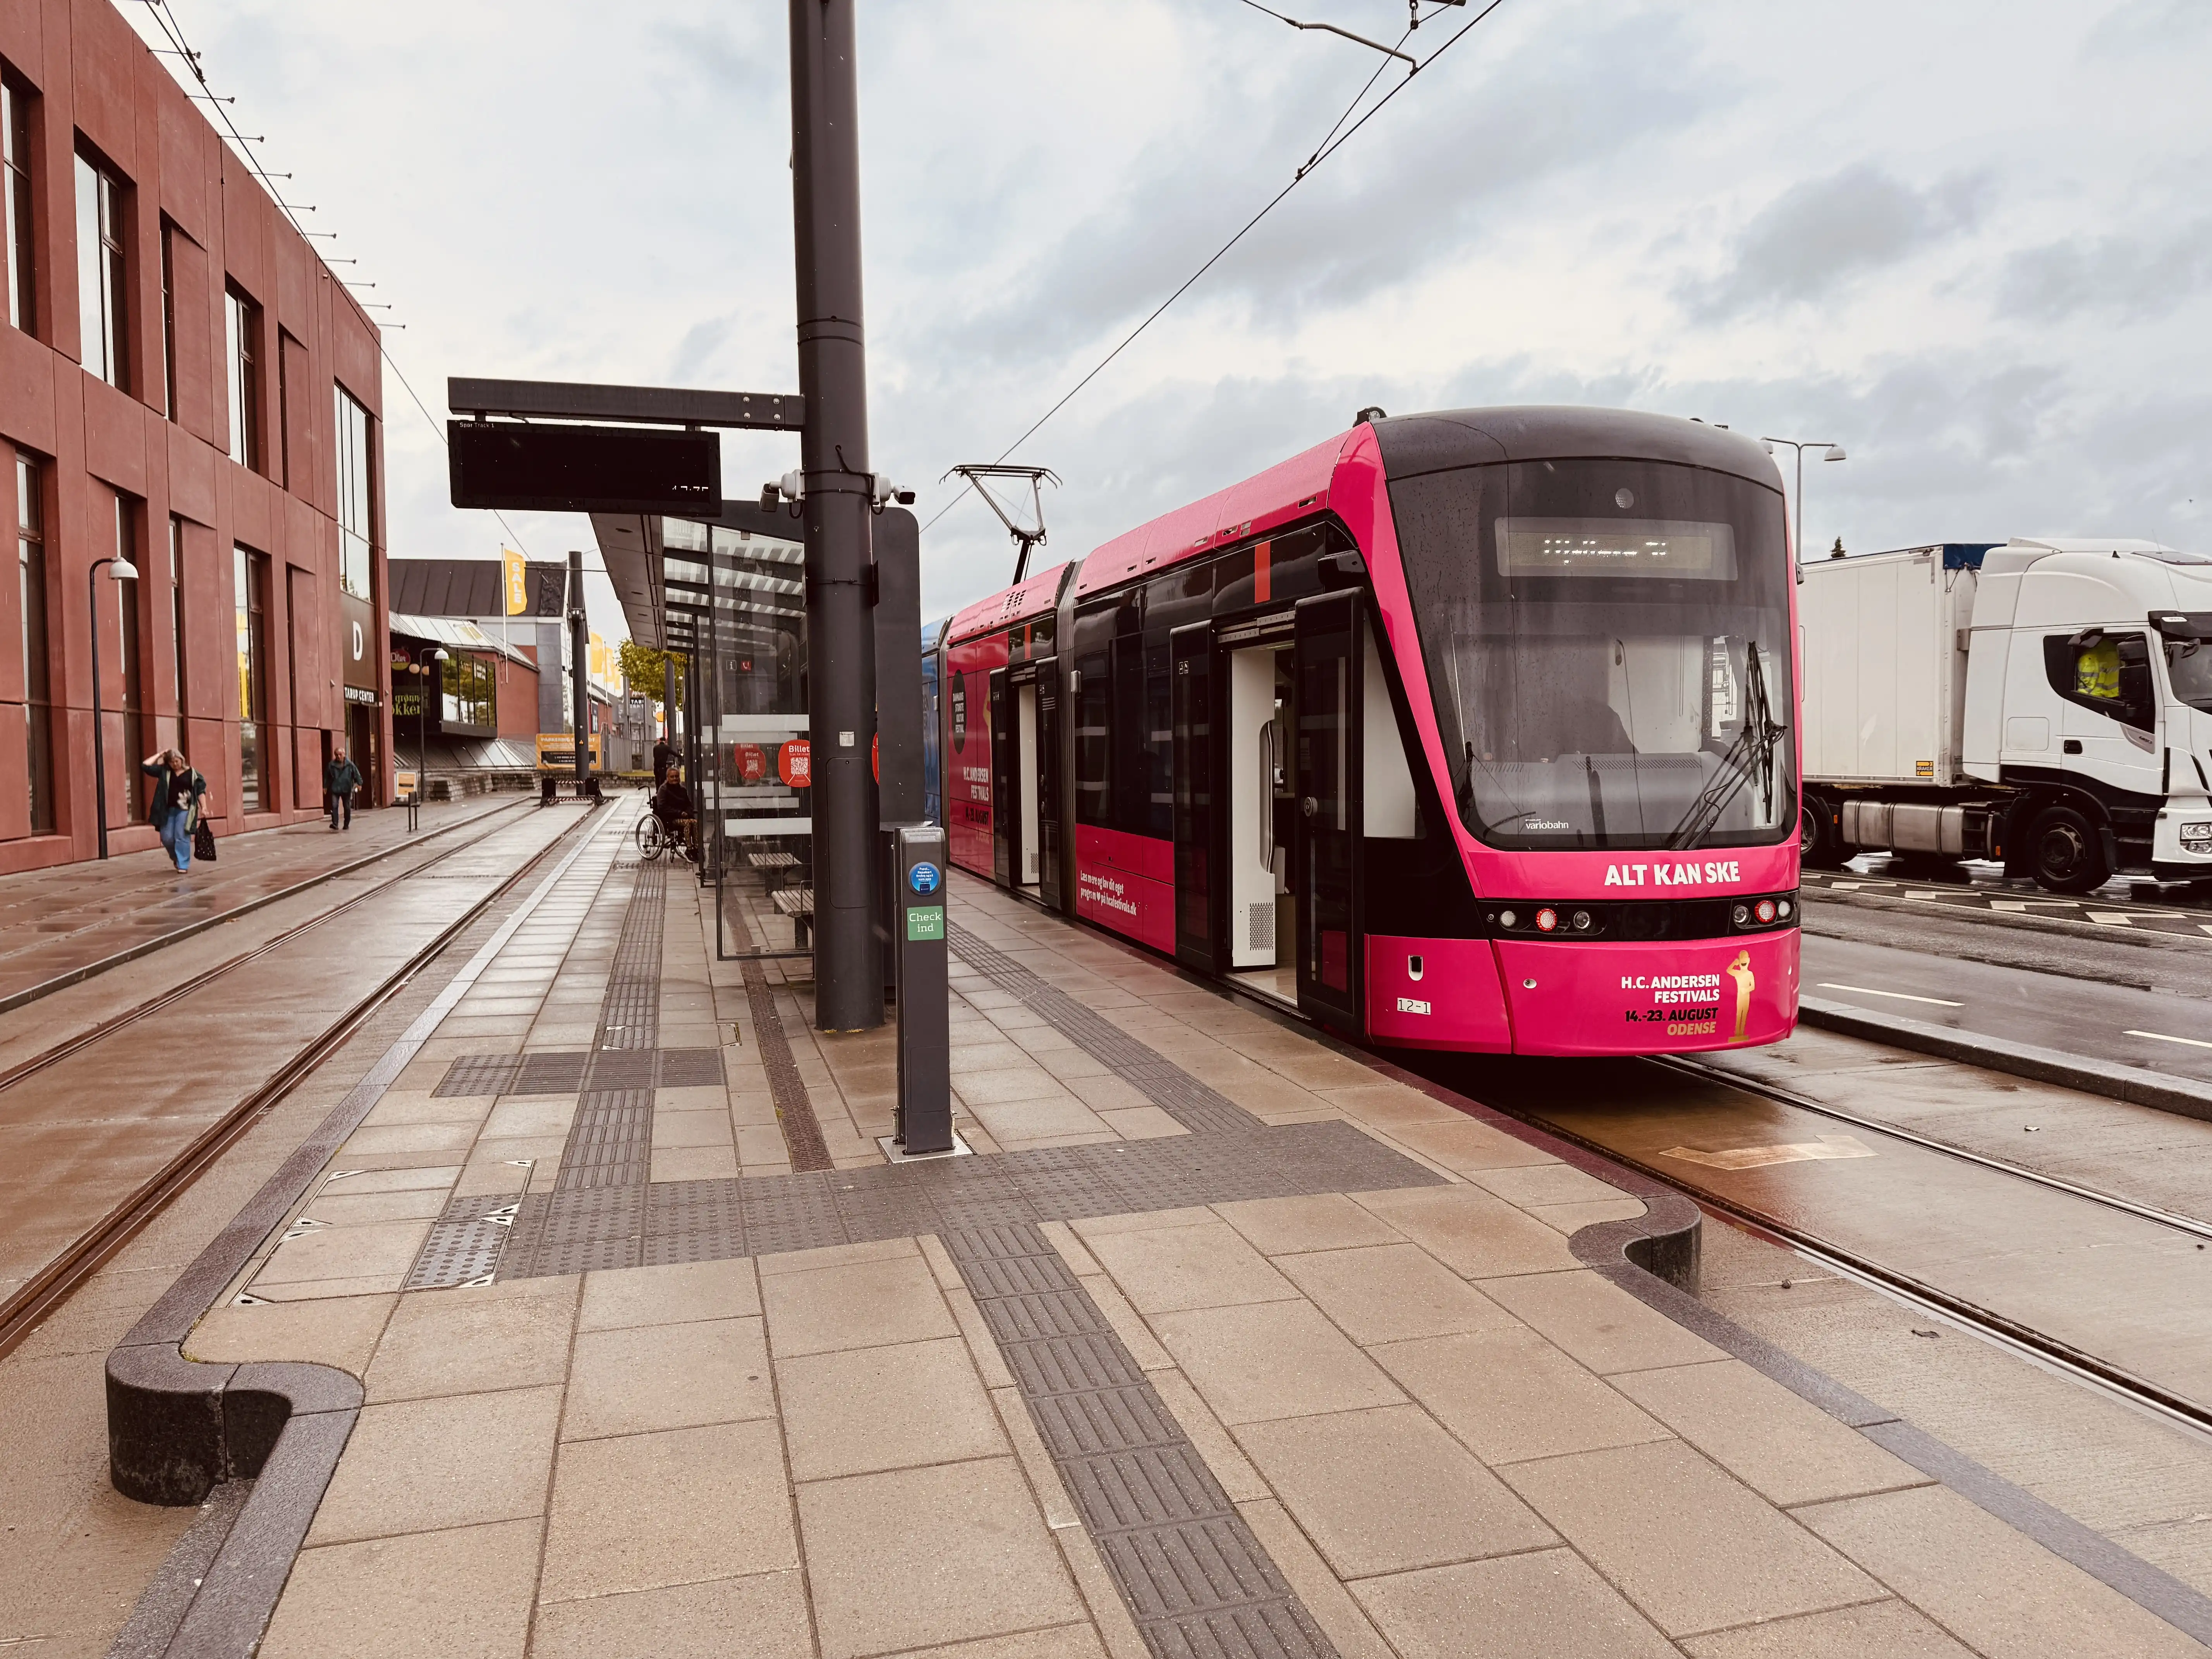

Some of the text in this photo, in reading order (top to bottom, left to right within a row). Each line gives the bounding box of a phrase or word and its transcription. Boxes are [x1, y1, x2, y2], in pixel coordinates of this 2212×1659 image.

[512, 562, 522, 603] SALE
[353, 620, 363, 661] D
[359, 690, 374, 703] CENTER
[1525, 821, 1569, 829] variobahn
[1604, 861, 1740, 886] ALT KAN SKE
[1087, 874, 1097, 885] mere
[1097, 878, 1103, 890] og
[1115, 883, 1124, 896] eget
[1080, 888, 1137, 916] program på hcafestivals.dk
[909, 912, 941, 922] Check
[917, 923, 934, 932] ind
[1621, 974, 1720, 989] H.C. ANDERSEN
[1654, 989, 1720, 1003] FESTIVALS
[1398, 1000, 1429, 1013] 12-1
[1625, 1007, 1719, 1022] 14.-23. AUGUST
[1667, 1022, 1716, 1036] ODENSE
